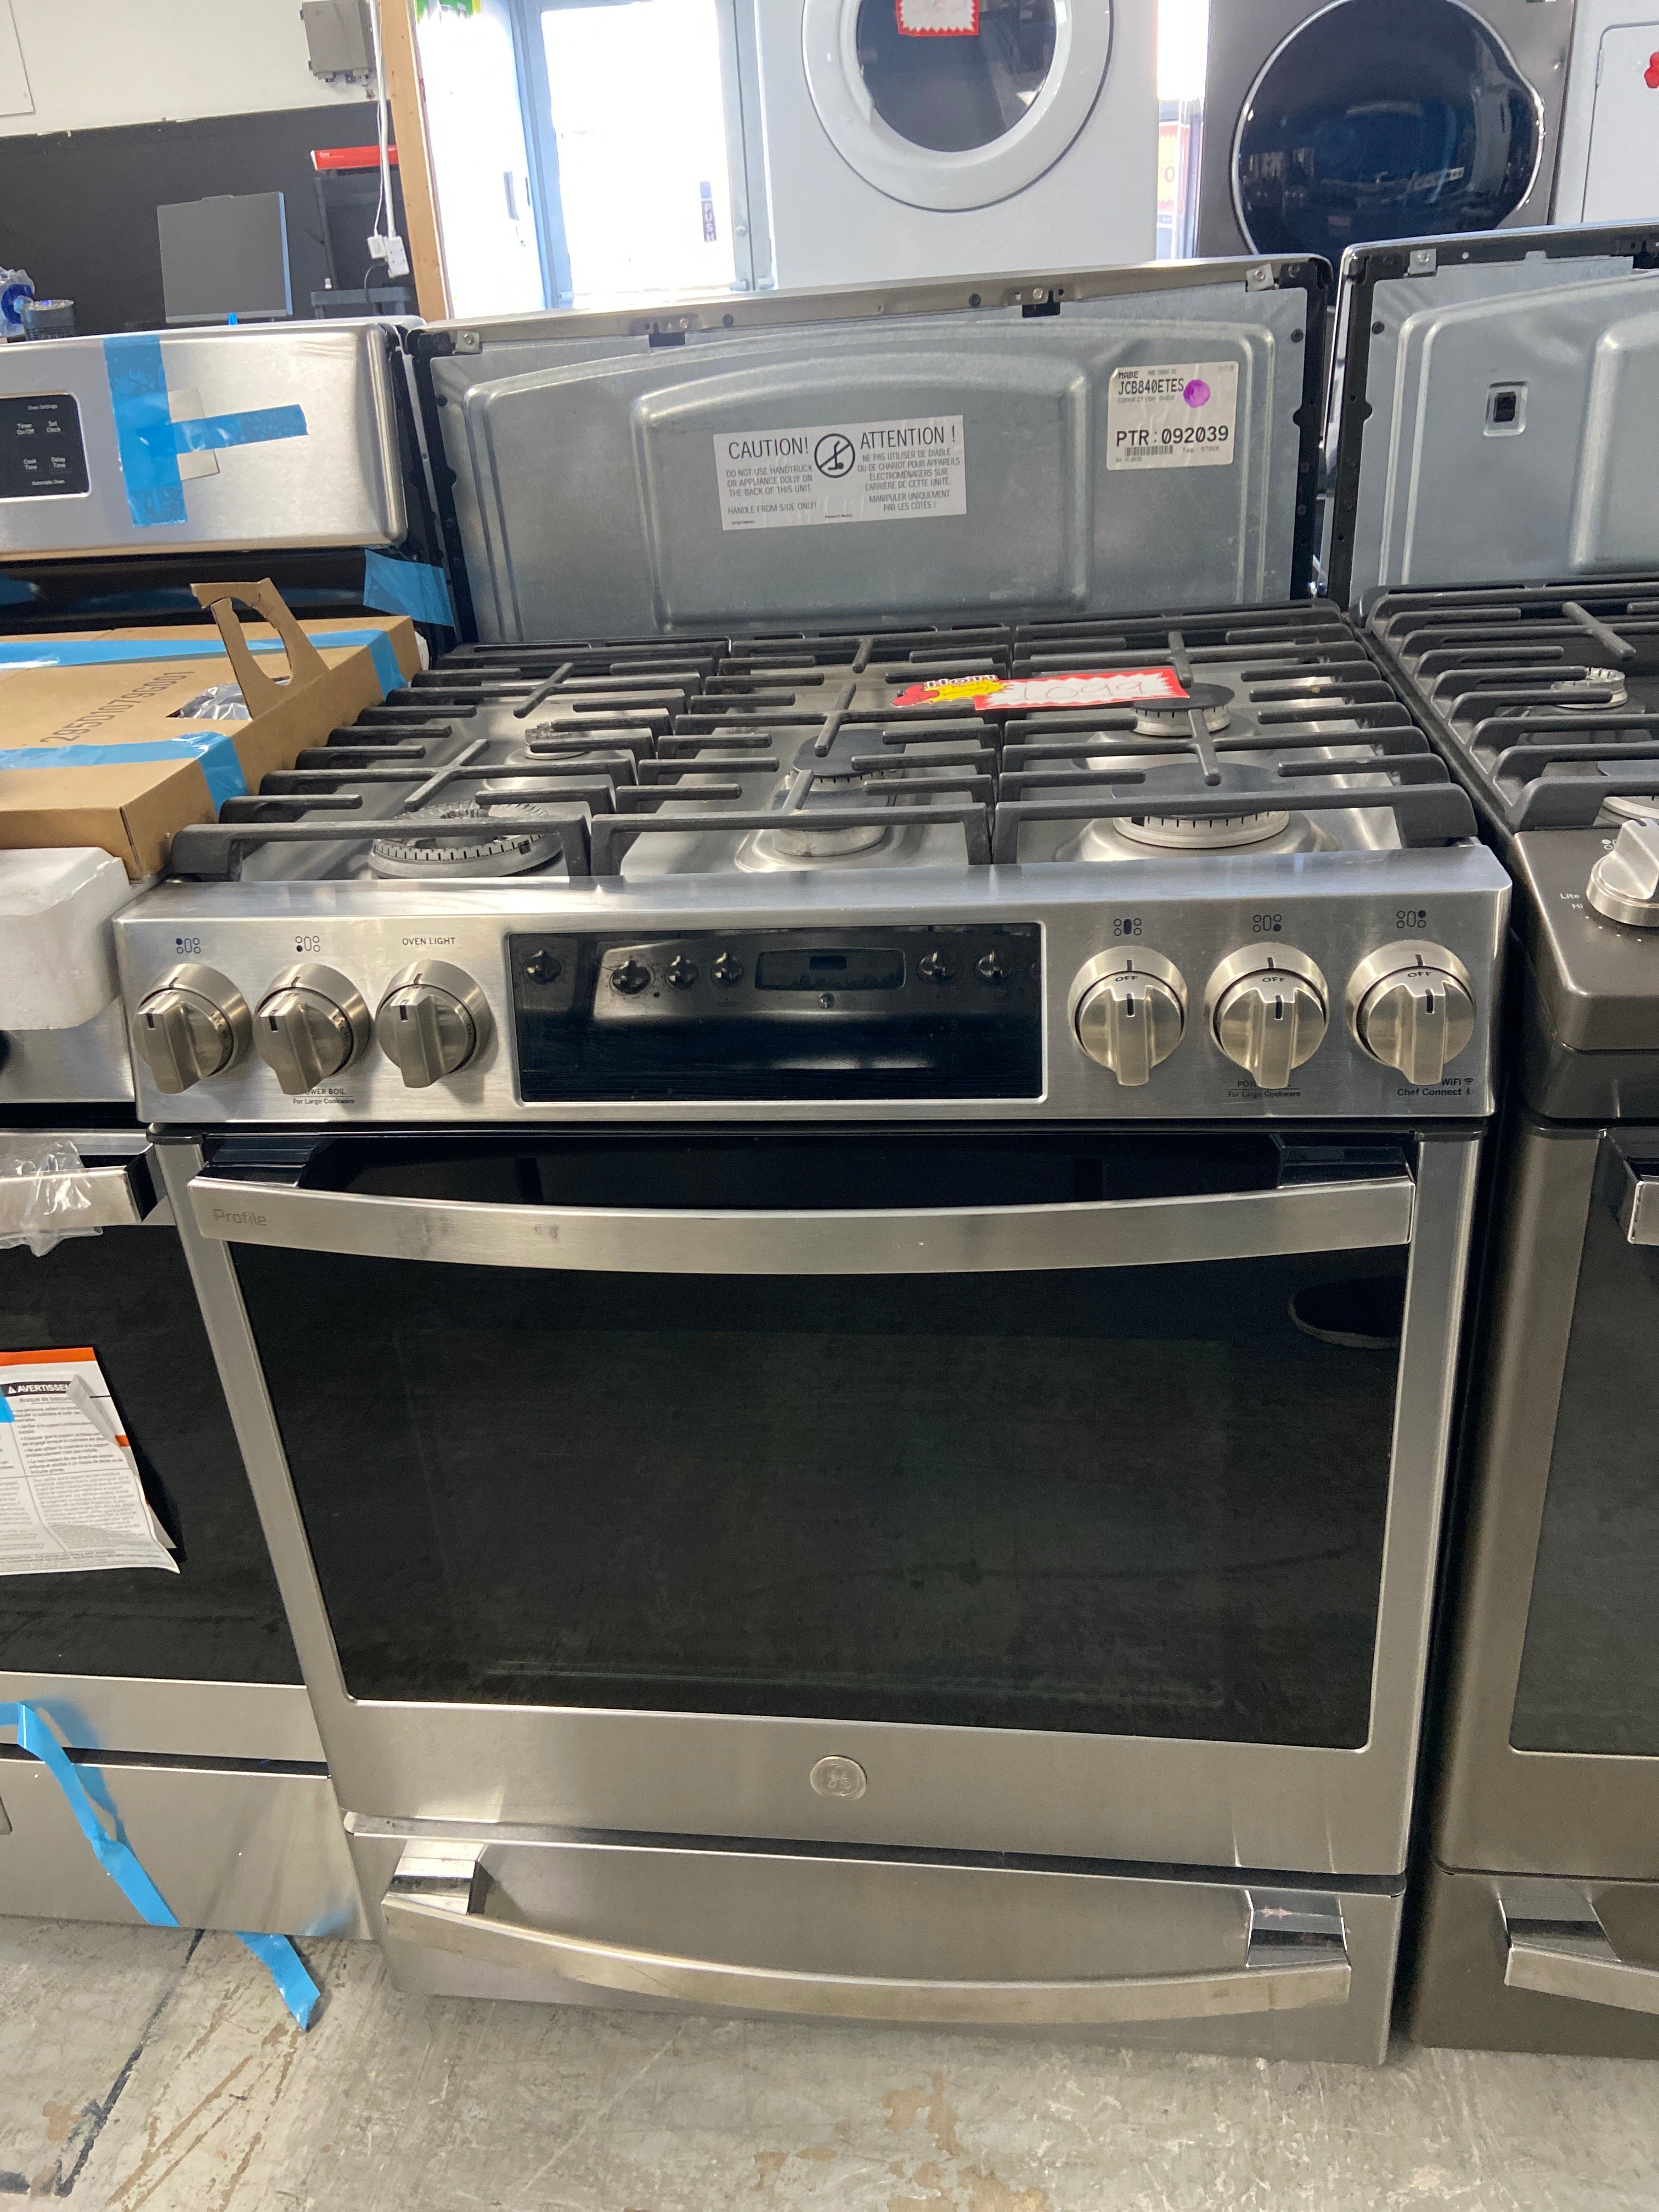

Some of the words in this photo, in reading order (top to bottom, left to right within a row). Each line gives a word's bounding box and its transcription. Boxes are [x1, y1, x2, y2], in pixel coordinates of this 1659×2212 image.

[1118, 378, 1184, 395] JCB840ETES
[860, 426, 944, 449] ATTENTION
[729, 437, 808, 459] CAUTION!
[887, 450, 916, 460] UTILISER
[928, 448, 951, 457] DIABLE
[868, 464, 877, 472] DE
[878, 461, 905, 471] CHARIOT
[907, 460, 925, 469] POUR
[927, 457, 961, 467] APPAREILS
[726, 470, 736, 478] DO
[738, 469, 752, 477] NOT
[754, 467, 768, 476] USE
[770, 465, 813, 475] HANDTRUCK
[934, 468, 948, 476] SUR
[727, 479, 737, 488] OR
[739, 477, 778, 487] APPLIANCE
[780, 475, 800, 484] DOLLY
[802, 474, 812, 482] ON
[898, 481, 906, 489] DE
[909, 479, 928, 488] CETTE
[729, 489, 742, 497] THE
[744, 488, 763, 496] BACK
[765, 487, 774, 495] OF
[777, 485, 793, 494] THIS
[869, 493, 906, 503] MANIPULER
[908, 490, 951, 500] UNIQUEMENT
[728, 505, 755, 515] HANDLE
[757, 504, 778, 513] FROM
[780, 503, 795, 511] SIDE
[883, 504, 896, 512] PAR
[898, 502, 910, 511] LES
[1024, 681, 1143, 701] 1099
[1397, 1088, 1420, 1096] Chef
[1422, 1088, 1463, 1096] Connect
[212, 1207, 268, 1227] Profile
